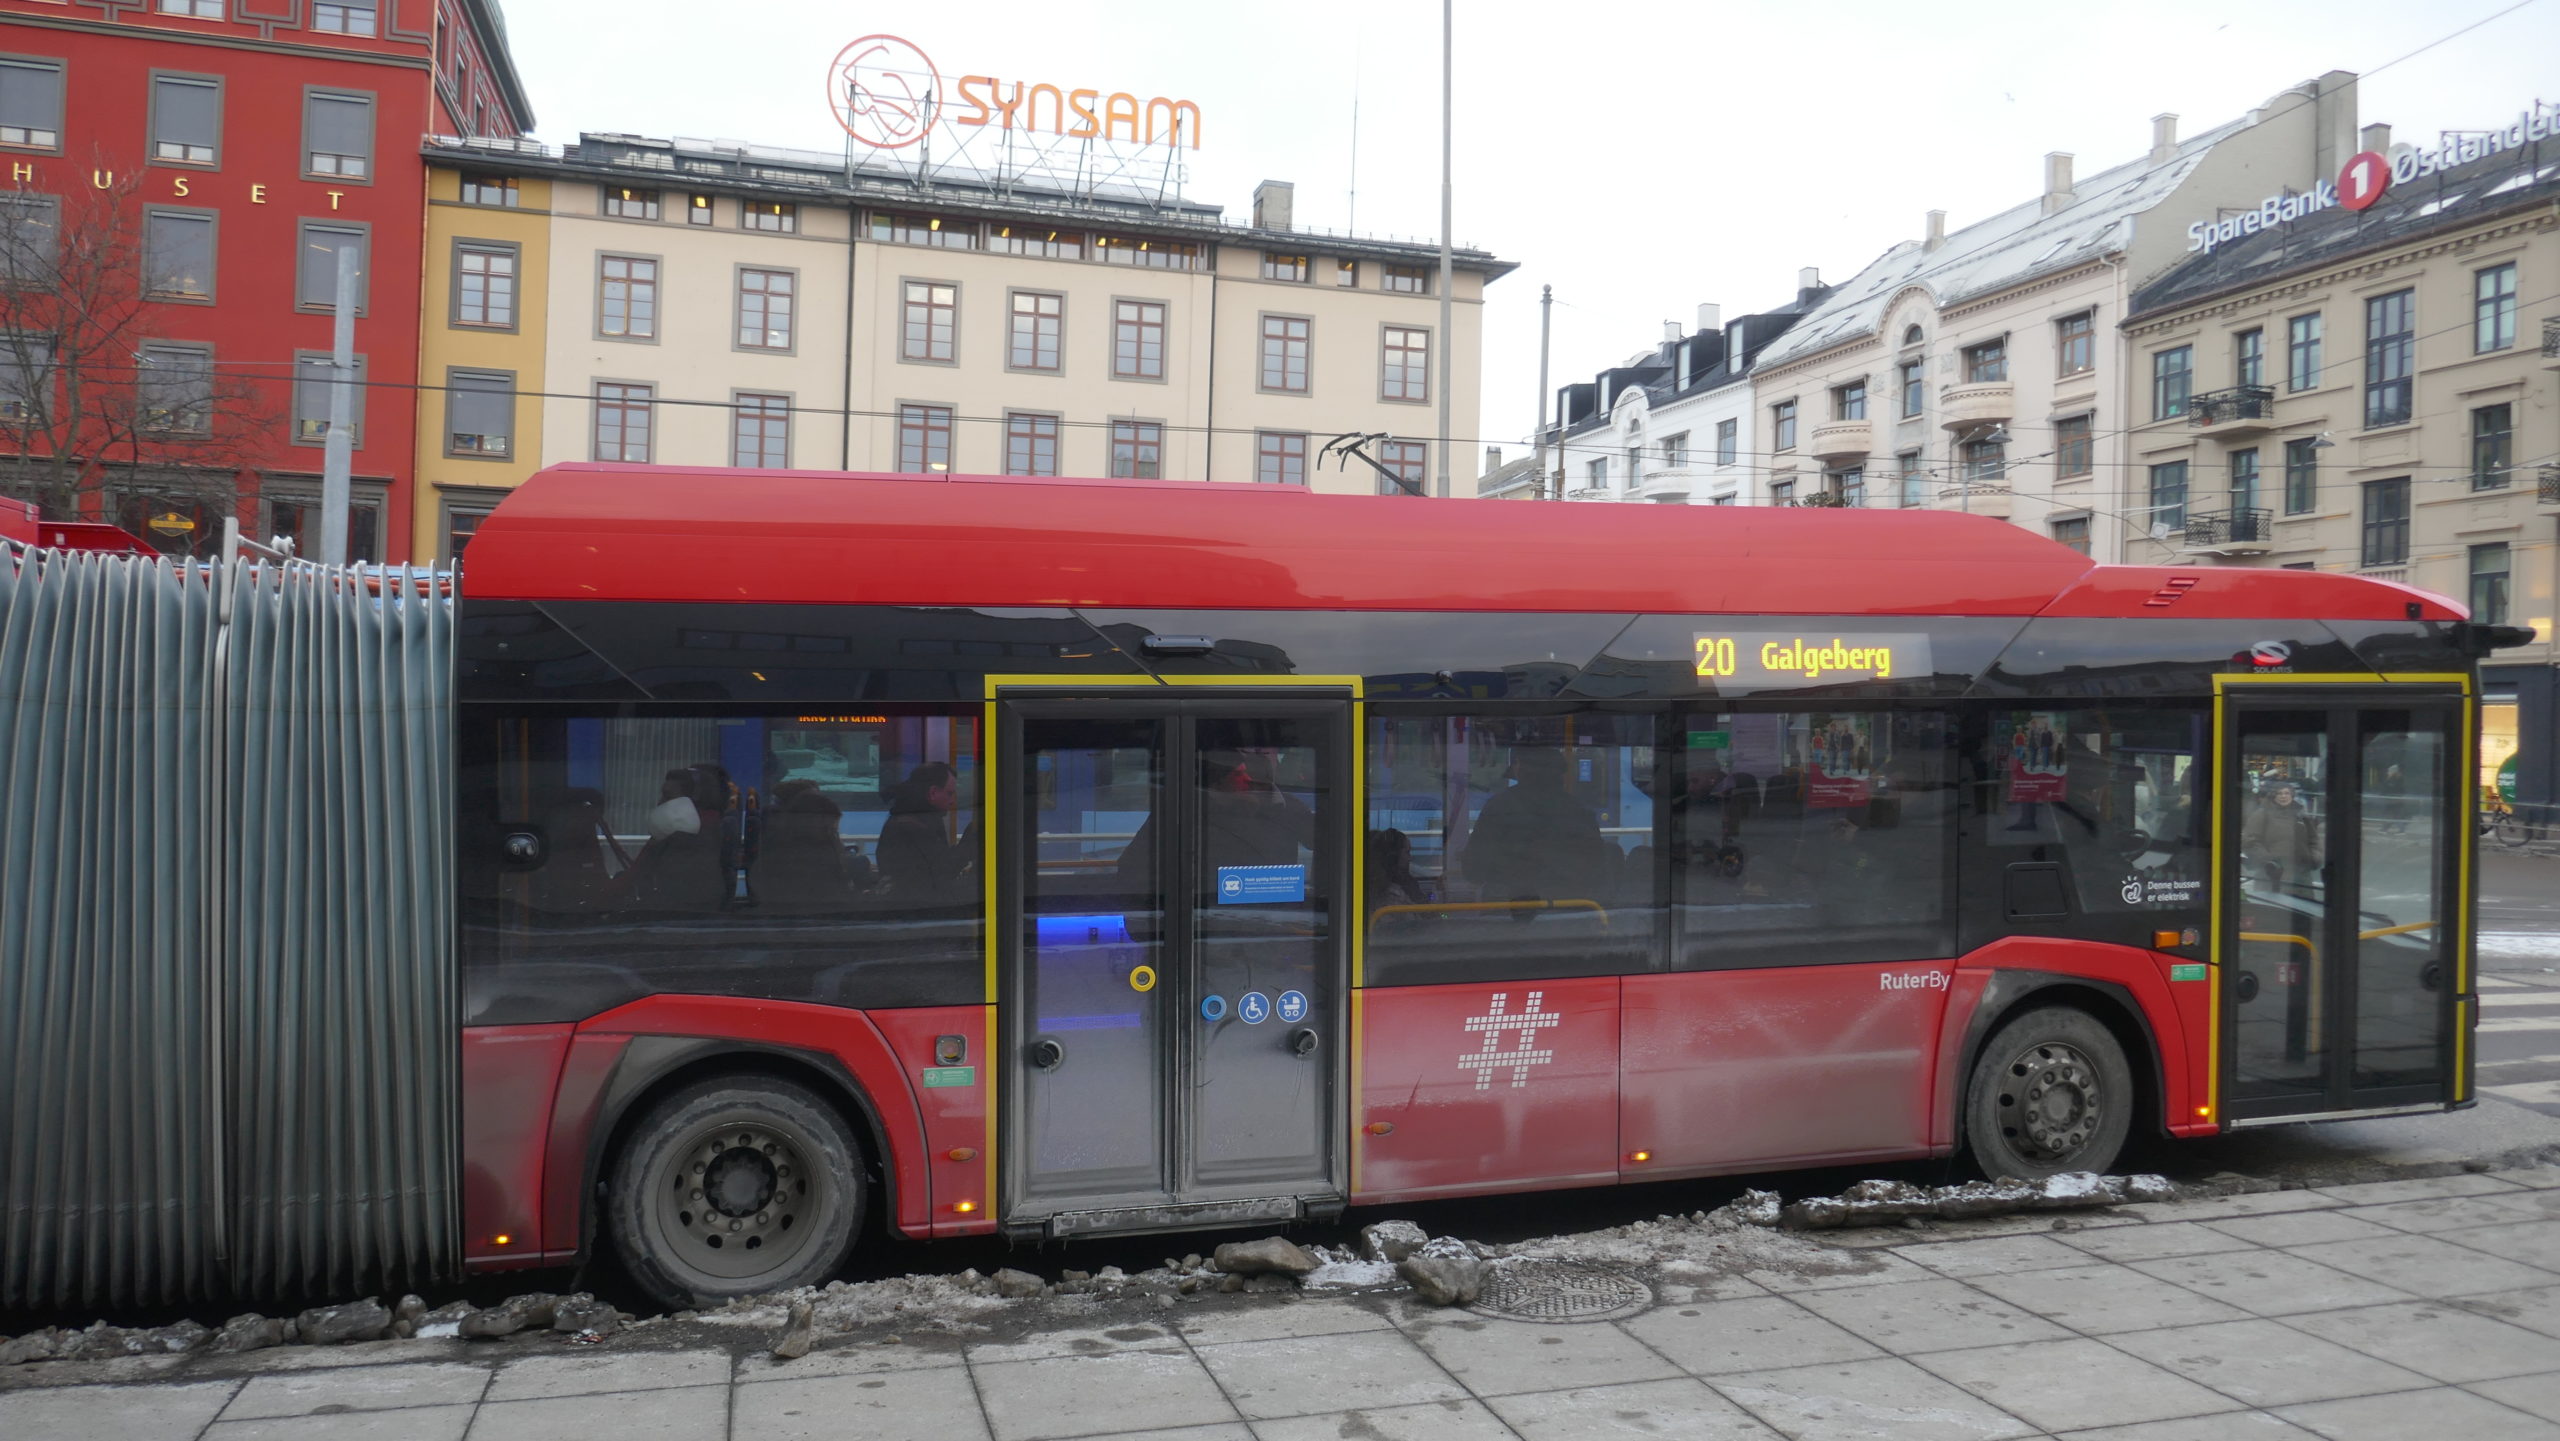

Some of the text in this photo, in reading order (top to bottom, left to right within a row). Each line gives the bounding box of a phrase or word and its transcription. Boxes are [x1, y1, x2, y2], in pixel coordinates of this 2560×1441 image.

[957, 75, 1200, 150] SYNSAM
[13, 162, 344, 210] HUSET
[2187, 179, 2338, 254] SpareBank
[2389, 103, 2560, 188] Østlandet
[1695, 637, 1892, 678] 20 Galgeberg
[2253, 666, 2293, 674] SOLARIS
[2147, 880, 2200, 890] Denne bussen
[2147, 892, 2190, 902] er elektrisk
[1880, 970, 1951, 992] RuterBy
